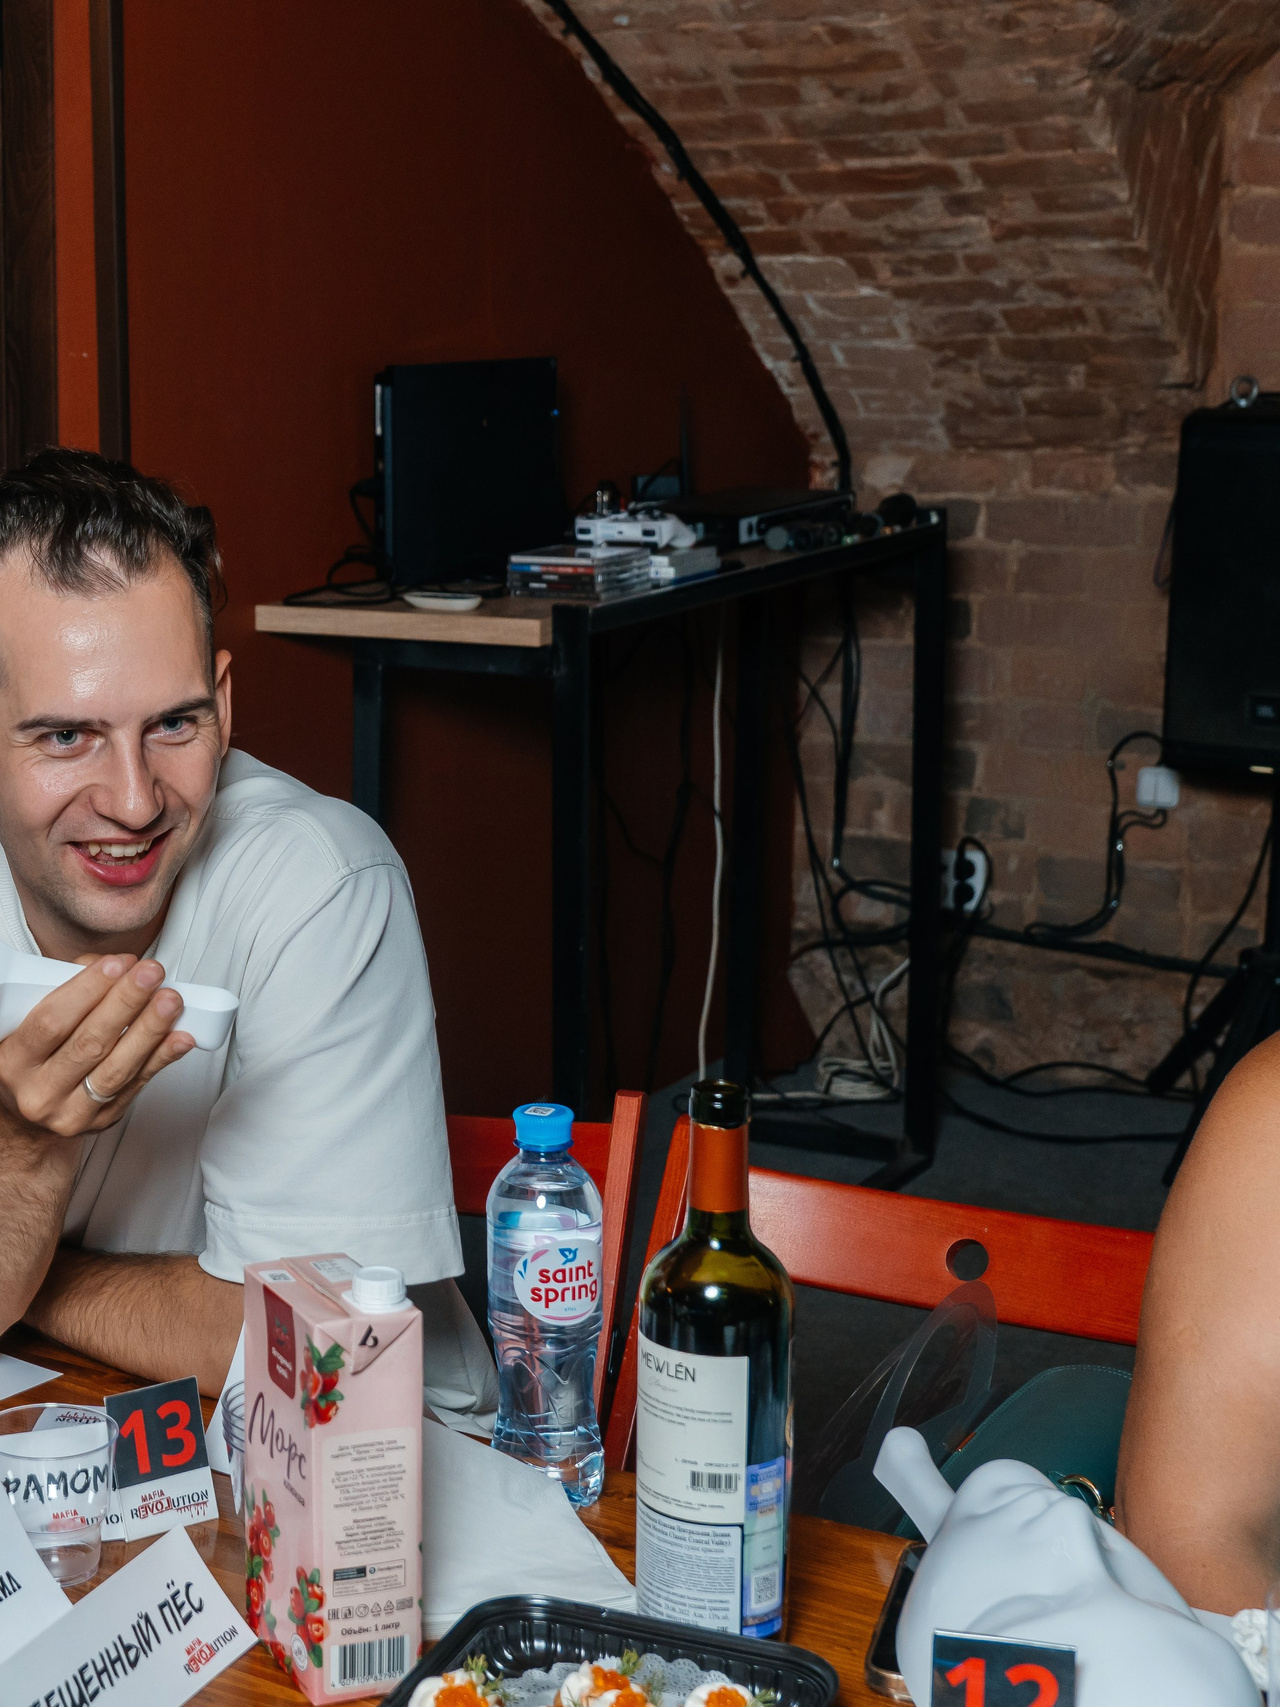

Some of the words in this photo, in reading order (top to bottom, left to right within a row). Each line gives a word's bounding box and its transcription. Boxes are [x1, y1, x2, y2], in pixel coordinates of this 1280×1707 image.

[538, 1259, 594, 1284] saint
[530, 1278, 598, 1309] spring
[641, 1348, 696, 1382] MEWLÉN
[120, 1399, 197, 1475] 13
[248, 1391, 307, 1480] Морс
[141, 1489, 166, 1503] MAFIA
[157, 1579, 205, 1635] ПЁС
[341, 1626, 372, 1636] Объём:
[381, 1622, 400, 1630] литр
[184, 1637, 204, 1655] MAFIA
